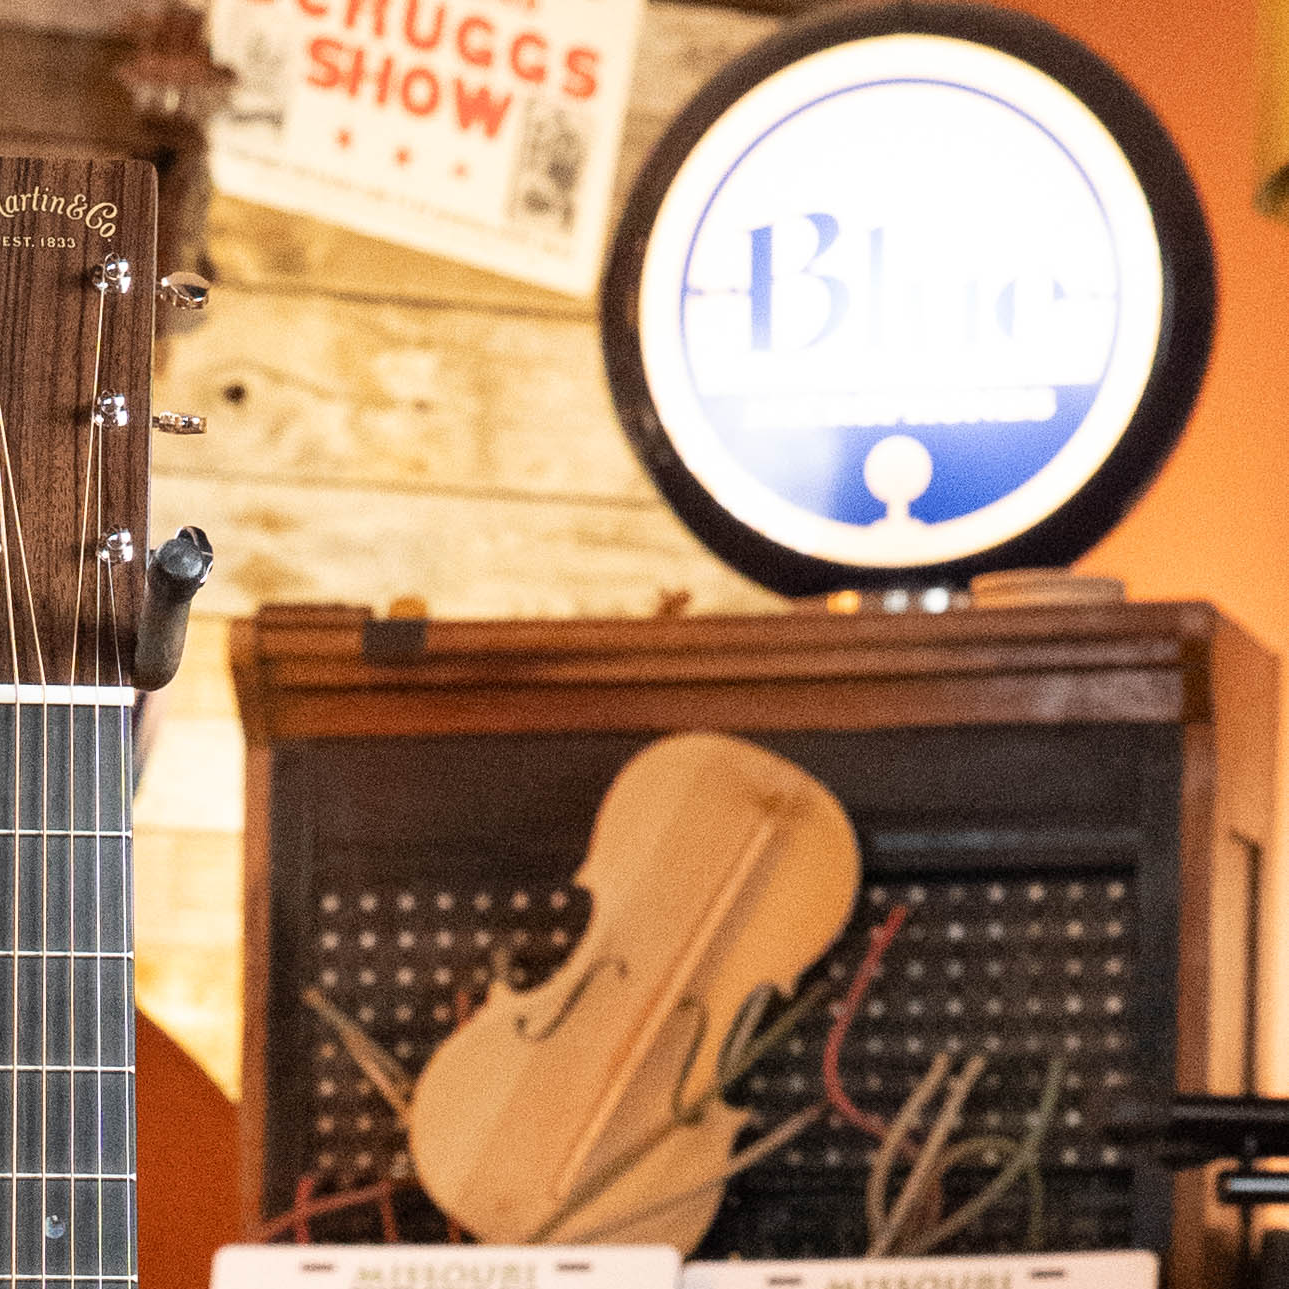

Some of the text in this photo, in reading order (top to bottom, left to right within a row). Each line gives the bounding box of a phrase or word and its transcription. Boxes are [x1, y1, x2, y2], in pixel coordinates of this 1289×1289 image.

[306, 37, 512, 138] SHOW
[1, 235, 77, 249] EST. 1833
